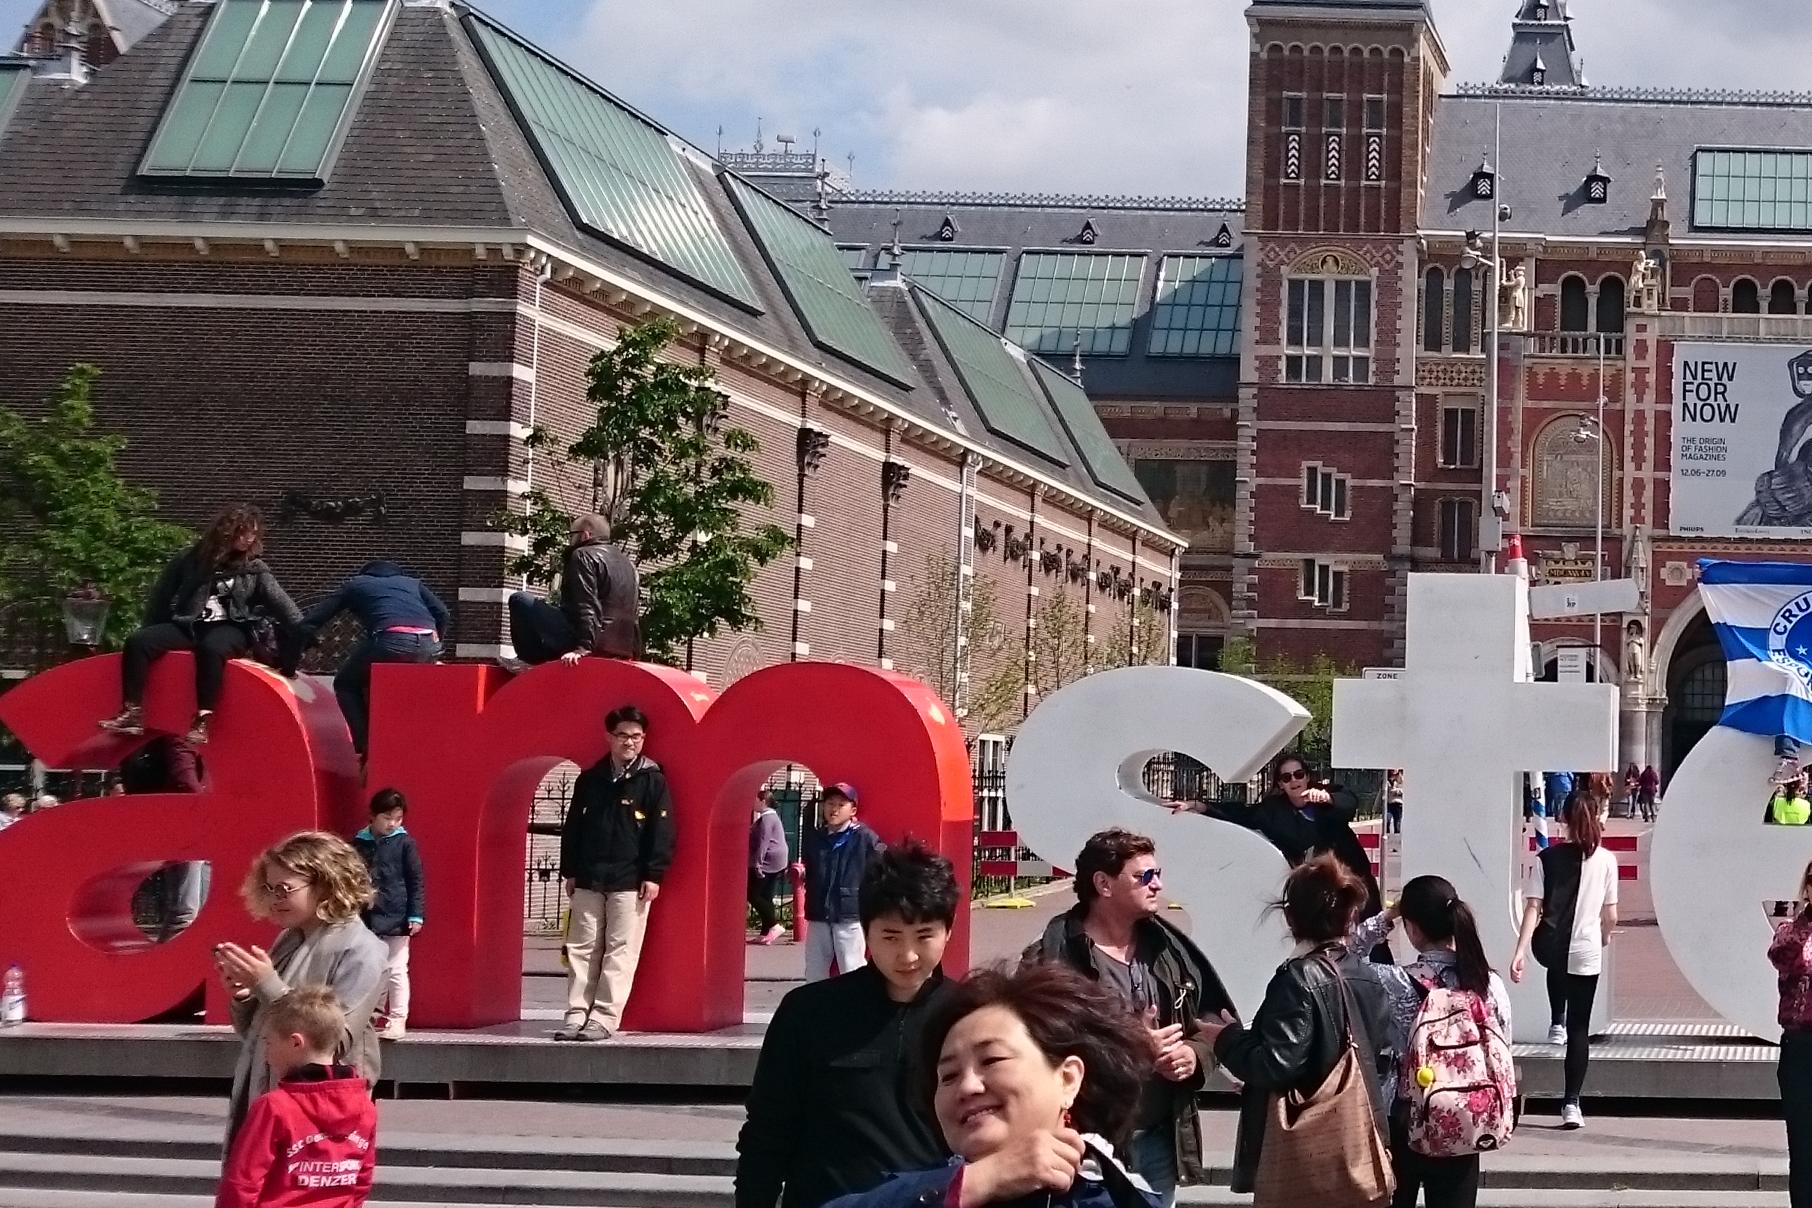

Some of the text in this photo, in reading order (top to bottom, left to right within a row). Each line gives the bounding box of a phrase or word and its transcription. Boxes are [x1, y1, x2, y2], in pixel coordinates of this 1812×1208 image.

[1682, 360, 1737, 382] NEW
[1682, 381, 1728, 402] FOR
[1681, 402, 1739, 423] NOW
[1681, 437, 1726, 445] THE ORIGIN
[1681, 445, 1728, 453] OF FASHION
[1680, 453, 1726, 461] MAGAZINES
[1376, 672, 1399, 680] ZONE
[297, 1173, 358, 1188] DENZER
